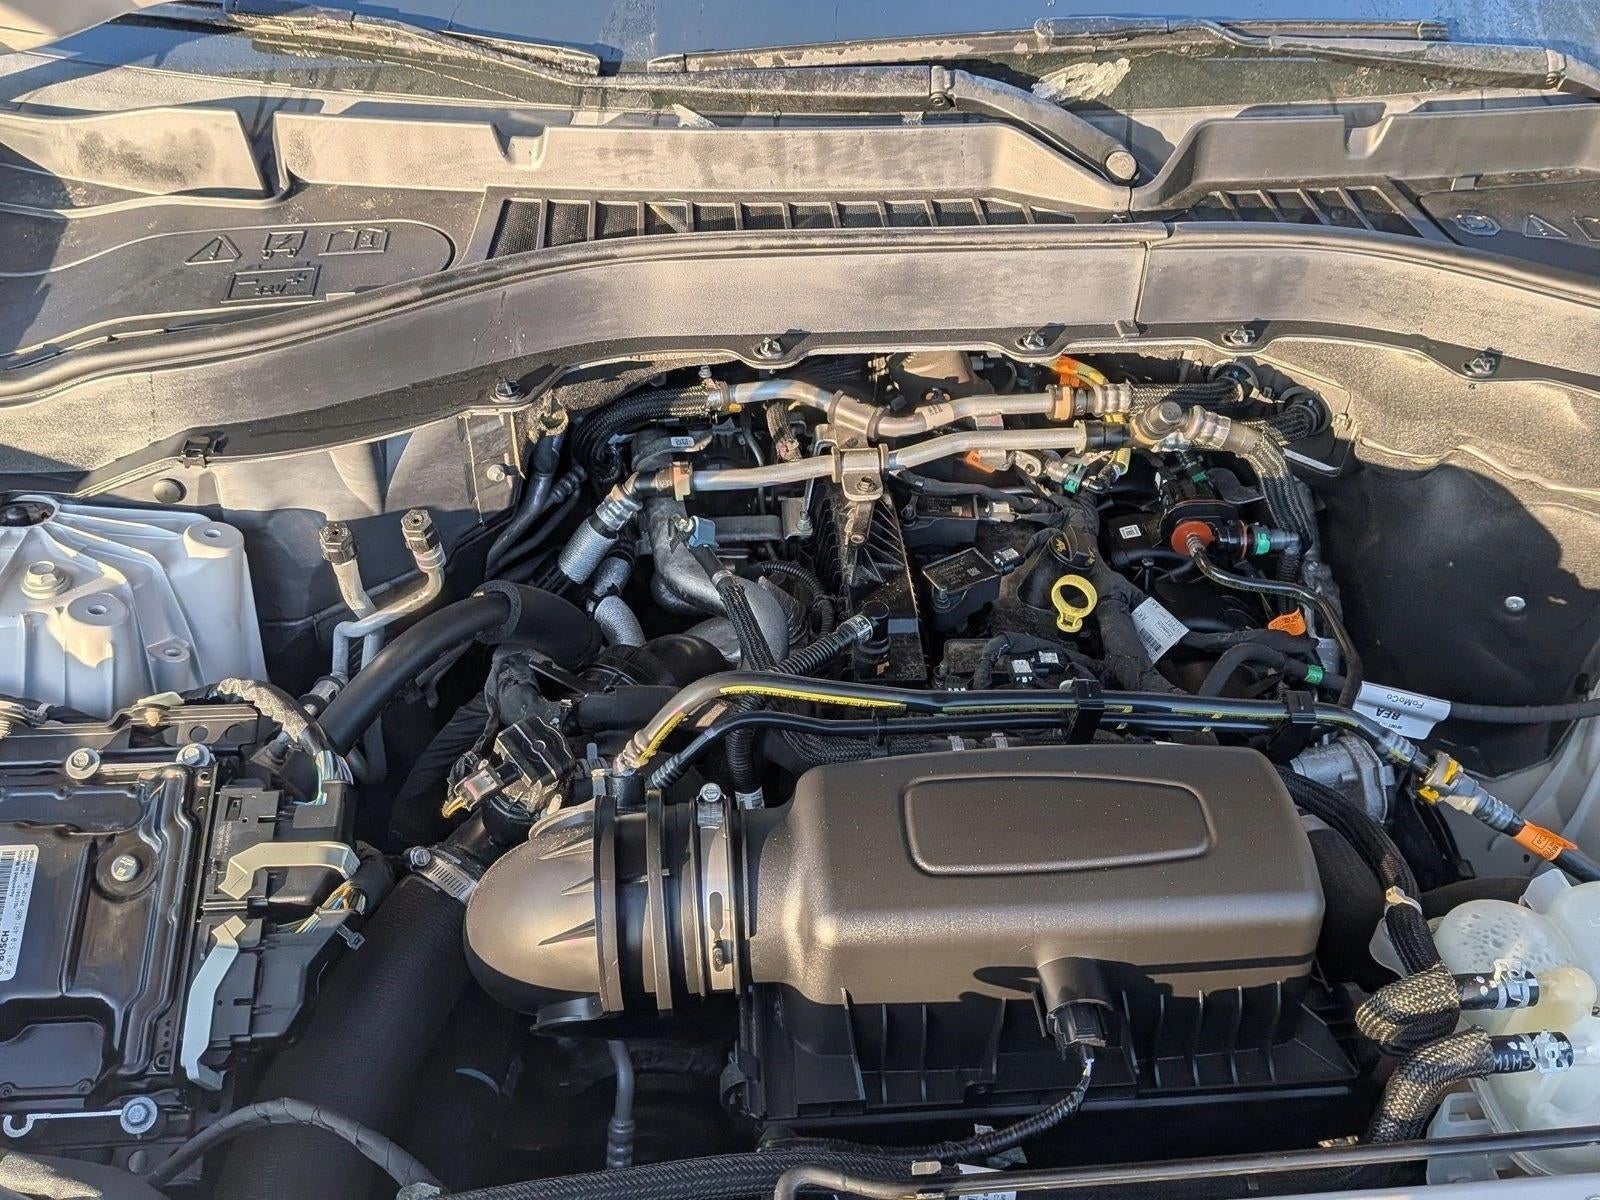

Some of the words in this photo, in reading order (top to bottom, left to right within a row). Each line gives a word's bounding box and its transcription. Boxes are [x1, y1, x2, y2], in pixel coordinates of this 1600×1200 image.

[1386, 693, 1425, 709] FoMoCo
[1375, 706, 1401, 721] BEA
[0, 930, 10, 961] BOSCH
